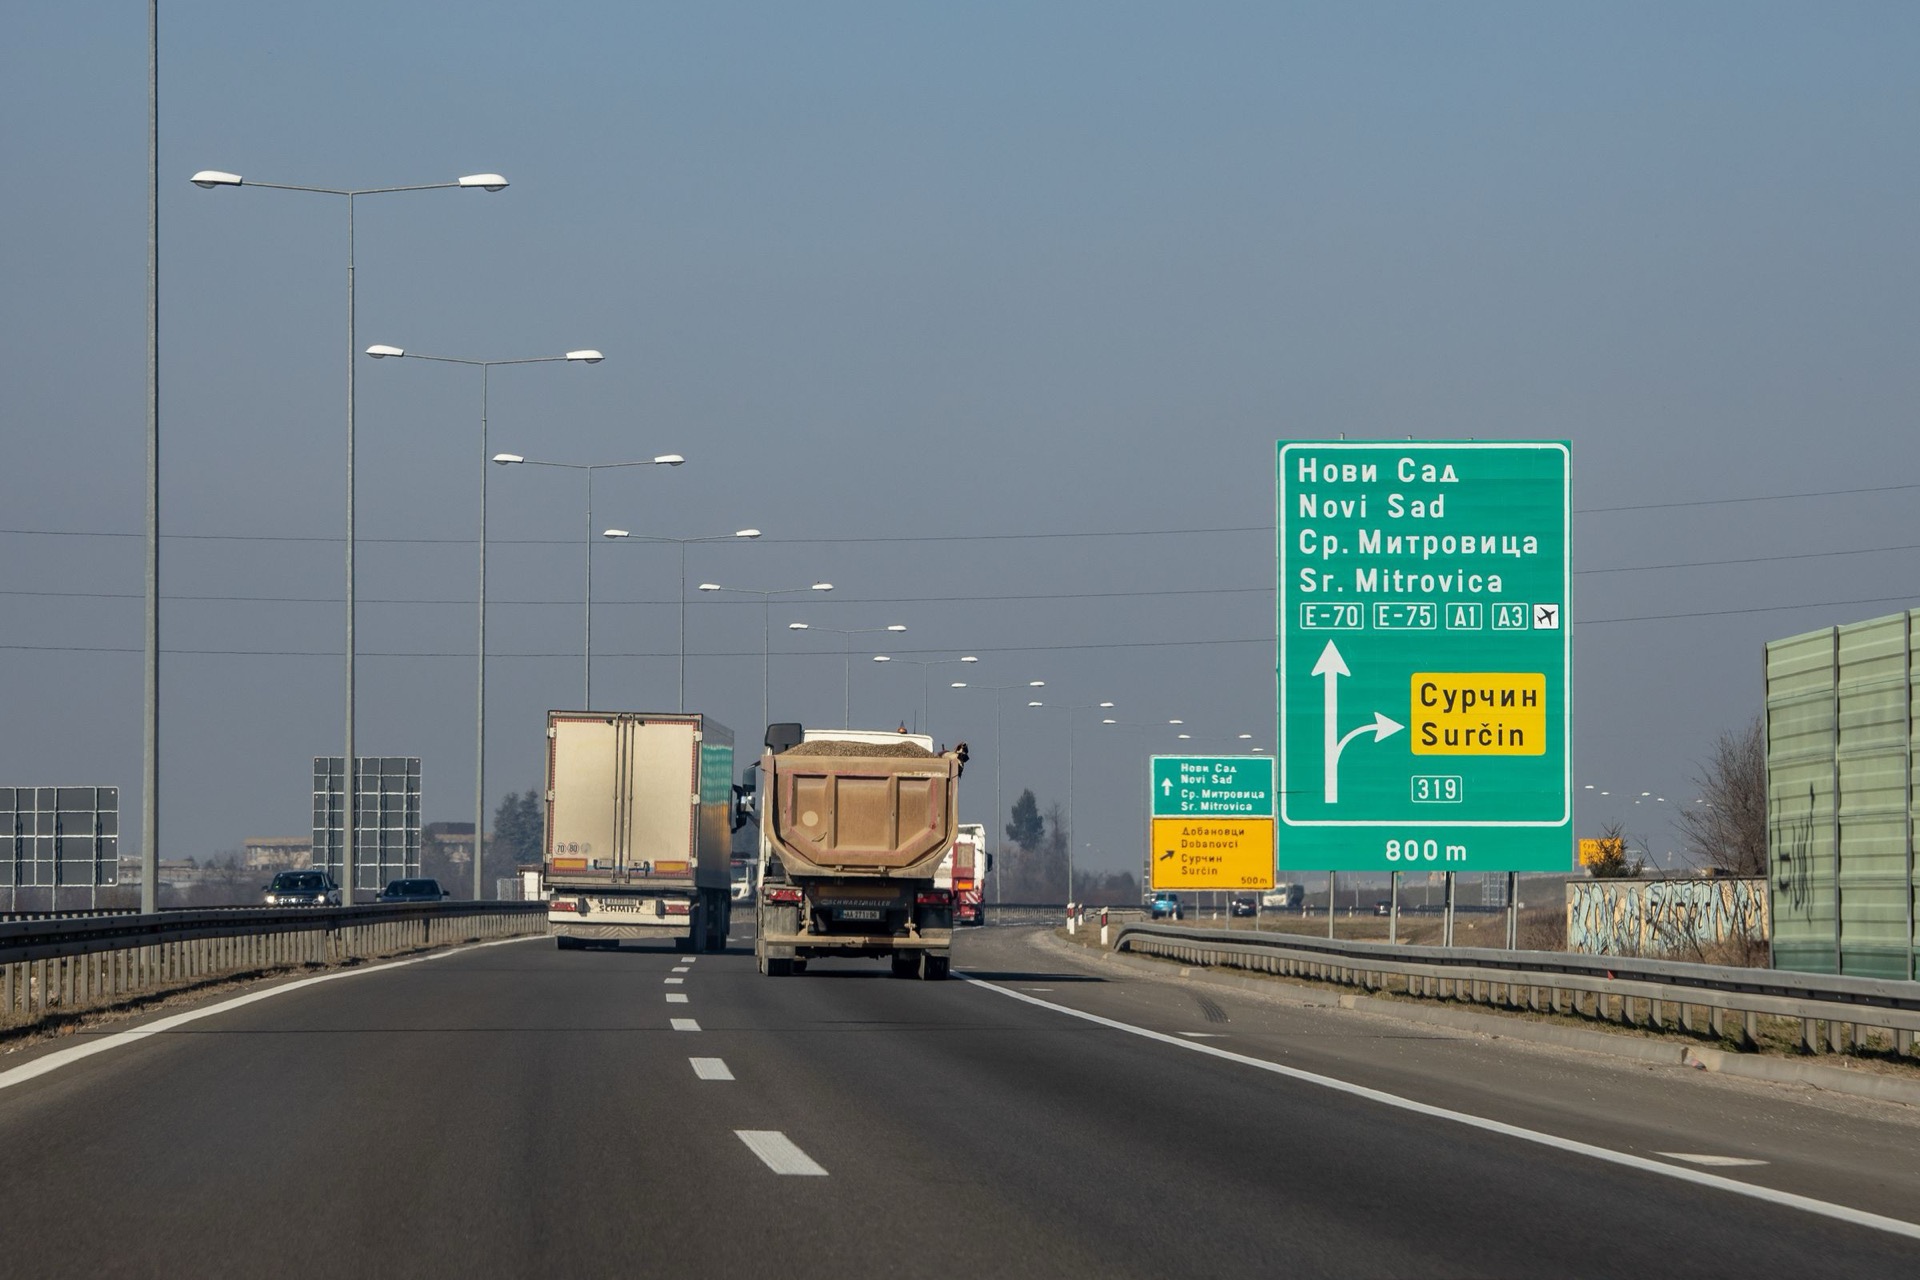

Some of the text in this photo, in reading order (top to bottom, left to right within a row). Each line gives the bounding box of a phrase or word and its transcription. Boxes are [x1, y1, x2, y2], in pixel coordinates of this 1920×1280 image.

[1298, 457, 1459, 483] Нови Сад
[1299, 493, 1445, 519] Novi Sad
[1299, 528, 1538, 561] Ср. Митровица
[1299, 567, 1502, 593] Sr. Mitrovica
[1304, 605, 1359, 628] E-70
[1378, 605, 1432, 628] E-75
[1454, 605, 1475, 627] A1
[1497, 605, 1523, 627] A3
[1420, 682, 1537, 714] Сурчин
[1421, 721, 1524, 747] Surčin
[1180, 762, 1237, 773] Нови Сад
[1180, 773, 1233, 785] Novi Sad
[1417, 778, 1457, 800] 319
[1180, 788, 1265, 801] Ср. Митровица
[1180, 801, 1253, 812] Sr. Mitrovica
[1181, 826, 1245, 837] Добановци
[1180, 838, 1238, 849] Dobanovci
[1385, 839, 1467, 862] 800 m
[1181, 853, 1223, 865] Сурчин
[1240, 876, 1268, 885] 500 m
[599, 905, 641, 913] SCHMITZ
